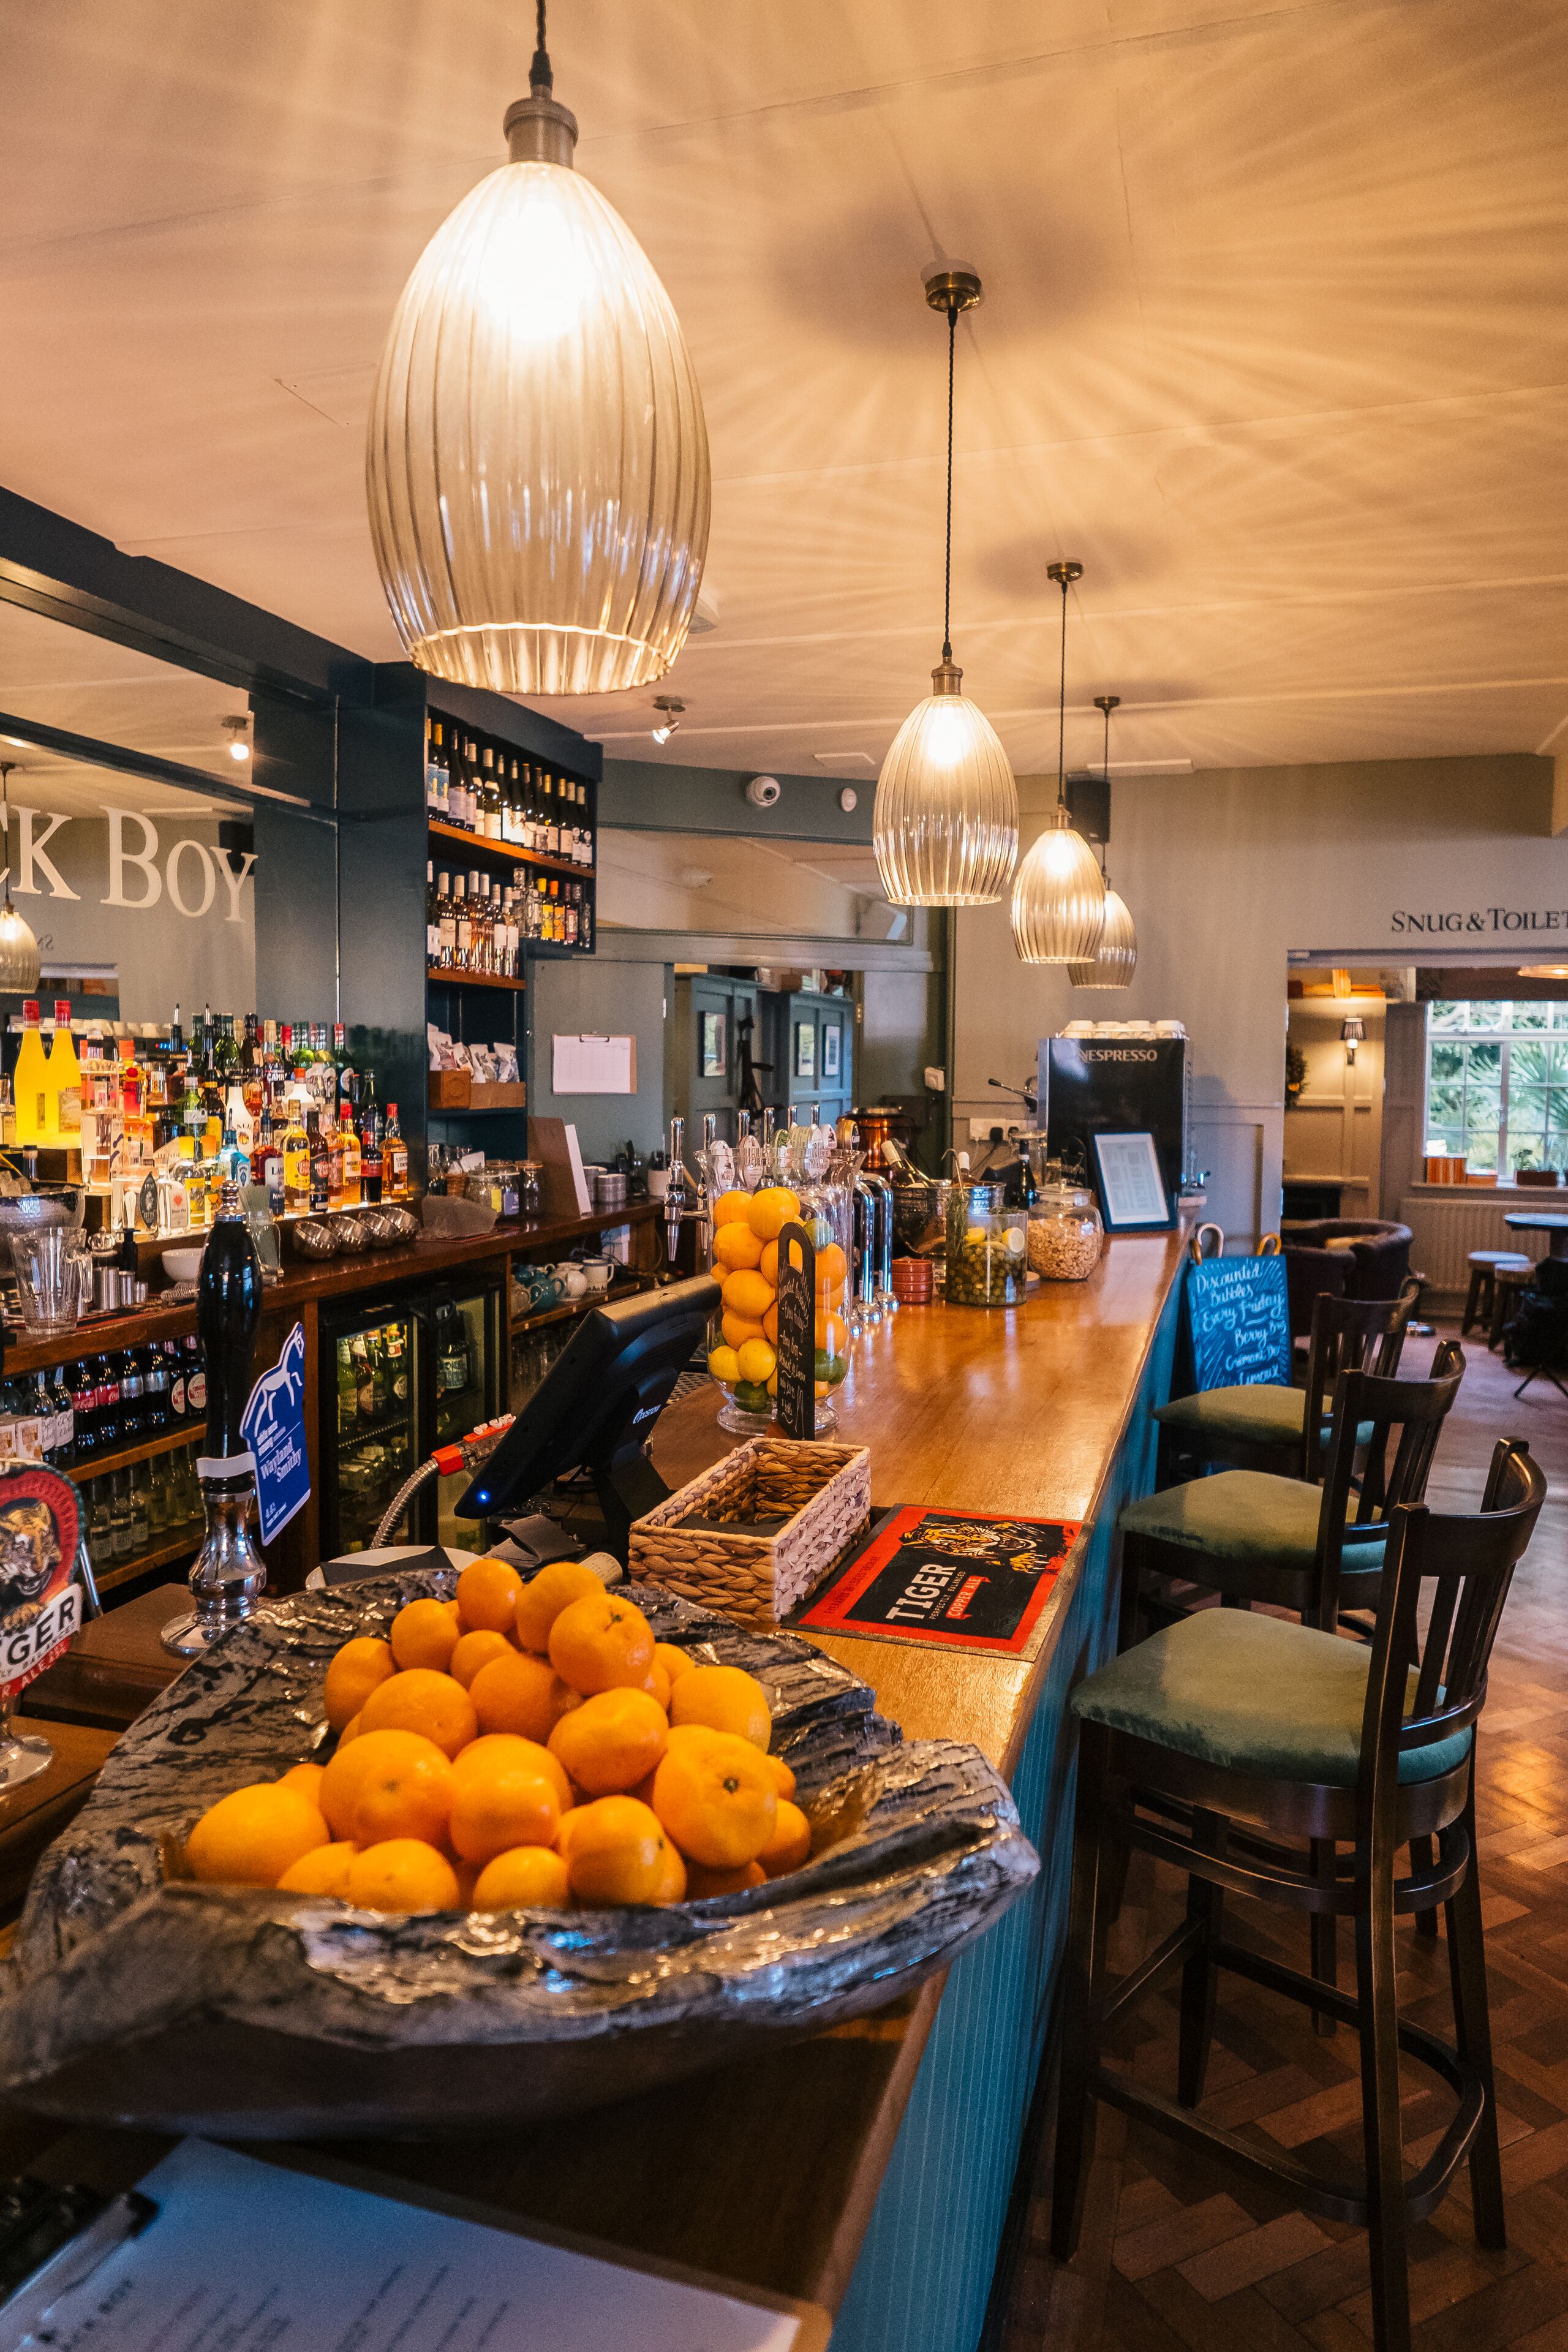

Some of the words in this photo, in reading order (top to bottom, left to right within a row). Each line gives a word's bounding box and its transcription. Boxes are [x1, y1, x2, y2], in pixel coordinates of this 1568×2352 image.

[100, 805, 258, 922] BOY
[1079, 1049, 1158, 1063] NESPRESSO
[1196, 1262, 1262, 1295] Discounted
[1203, 1308, 1237, 1332] Every
[1239, 1293, 1285, 1323] Friday
[259, 1436, 294, 1480] Wayland
[276, 1447, 301, 1483] Smithy
[886, 1564, 957, 1619] TIGER
[929, 1594, 951, 1620] PERFECTLY
[948, 1571, 967, 1592] BALANCED
[948, 1591, 973, 1617] COPPER
[965, 1577, 981, 1590] ALE
[0, 1595, 74, 1666] GER
